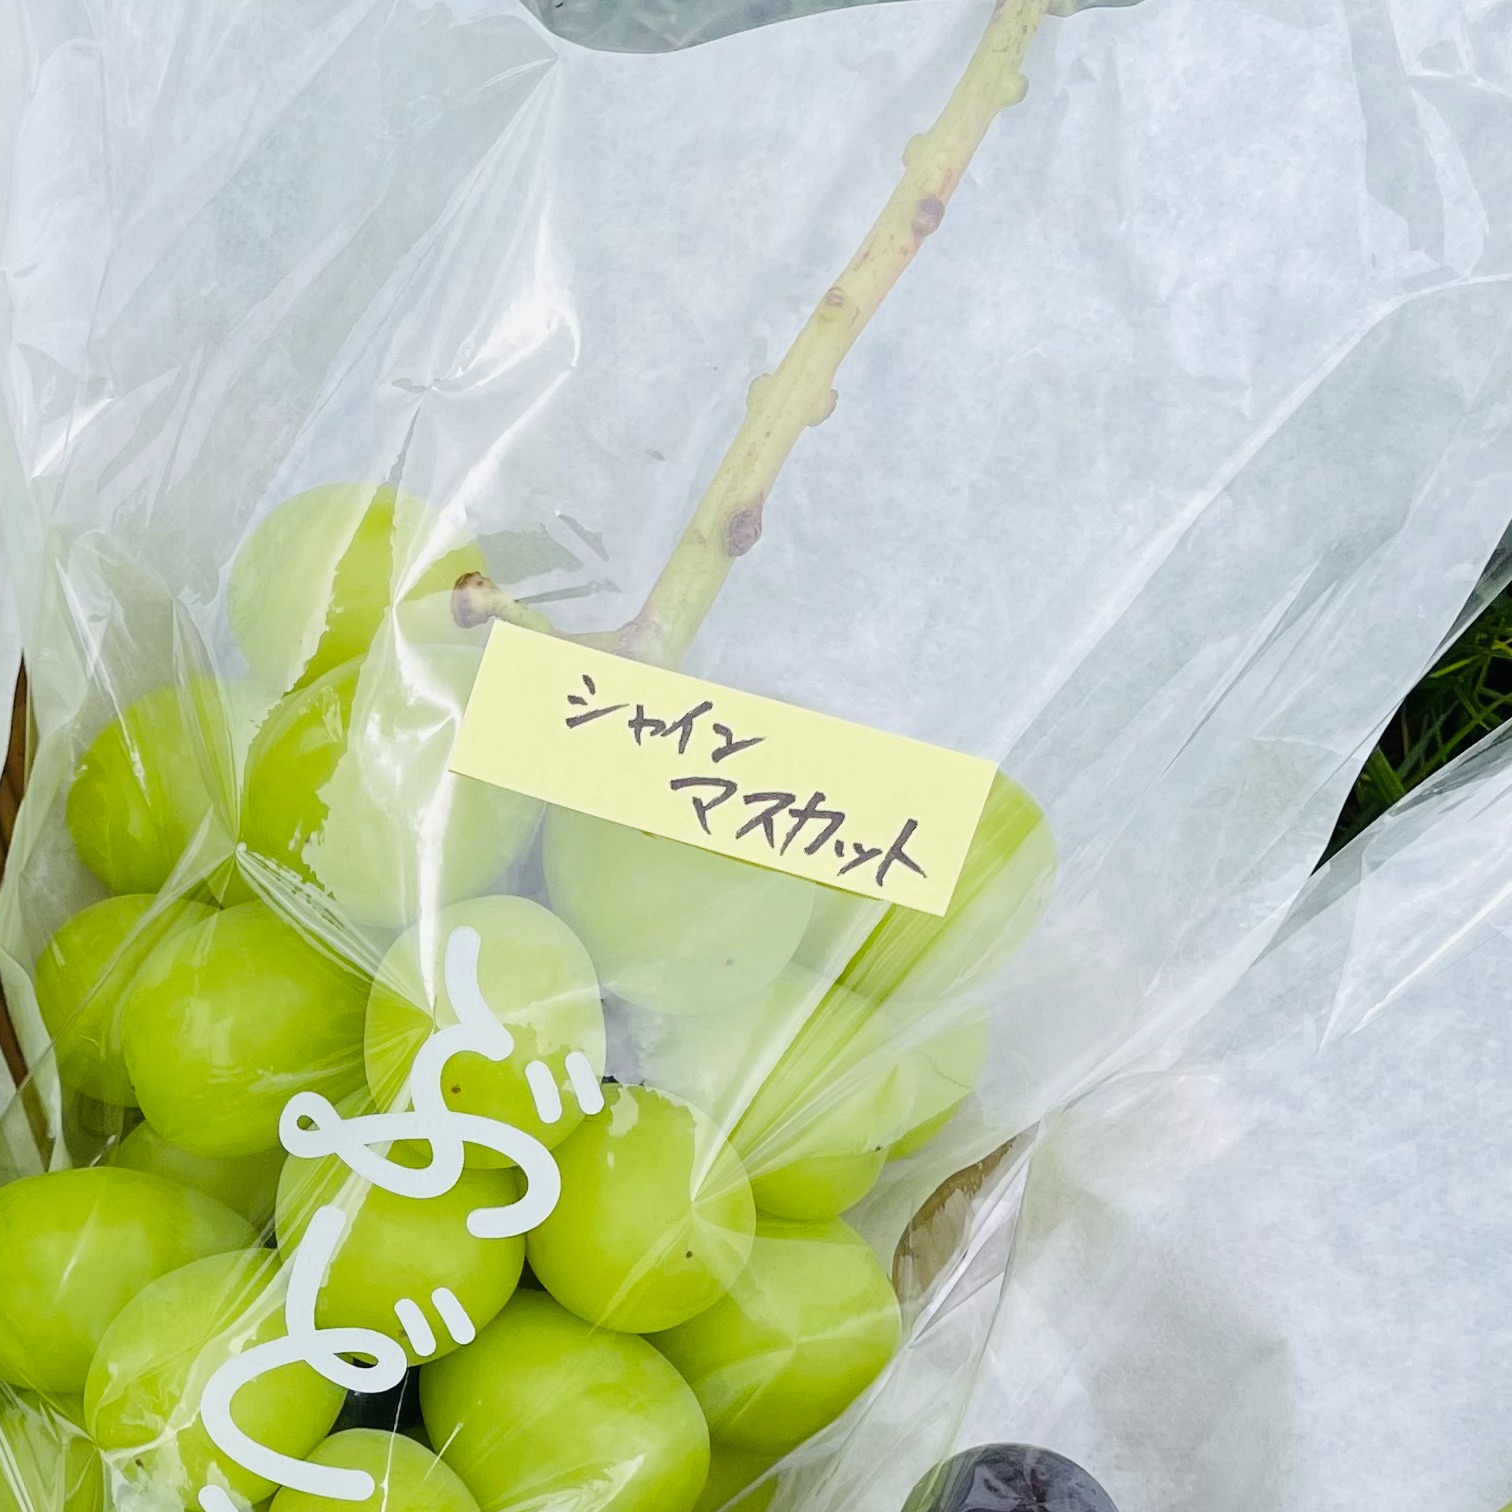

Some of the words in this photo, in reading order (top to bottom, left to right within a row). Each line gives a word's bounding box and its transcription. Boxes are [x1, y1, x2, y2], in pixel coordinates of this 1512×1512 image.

[565, 674, 768, 764] シャイン
[671, 776, 928, 887] マスカット
